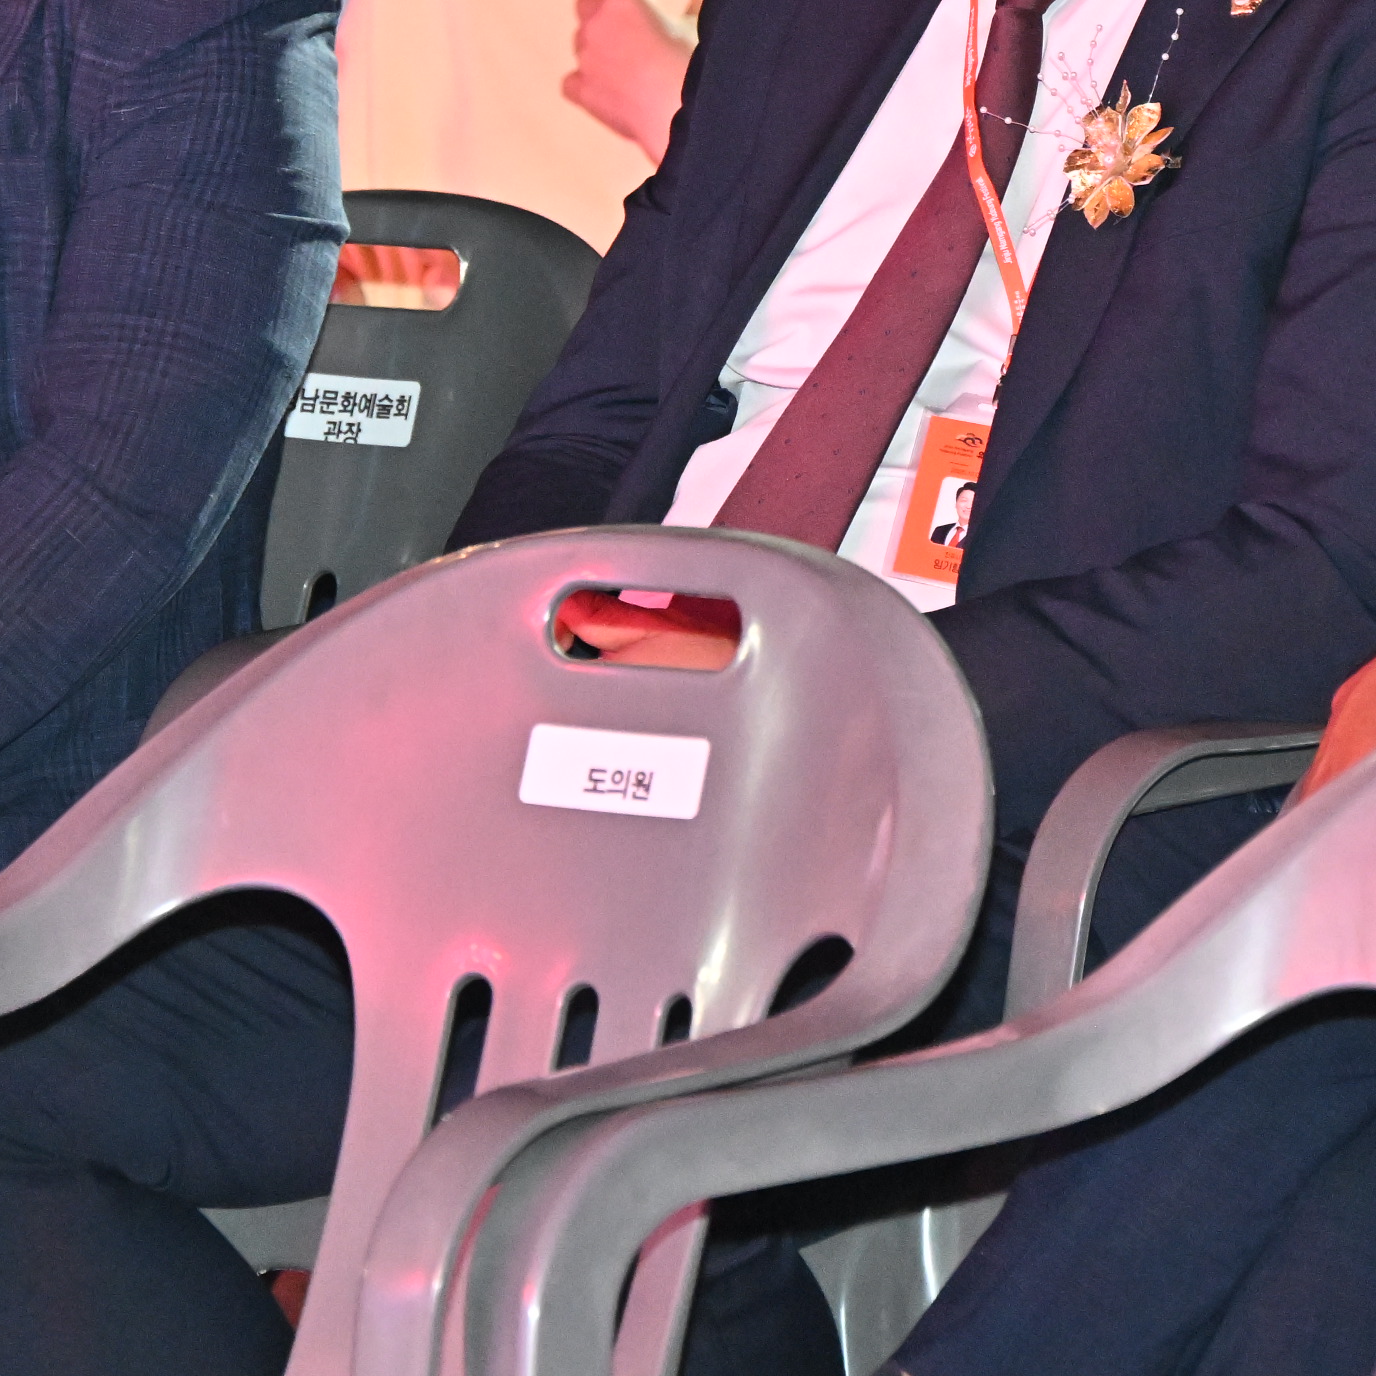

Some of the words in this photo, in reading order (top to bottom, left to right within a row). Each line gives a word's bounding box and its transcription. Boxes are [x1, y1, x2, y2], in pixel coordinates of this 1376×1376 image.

[976, 176, 990, 200] Festival
[986, 198, 998, 222] Yudeung
[994, 221, 1007, 250] Namgang
[1002, 250, 1012, 263] Jinju
[294, 387, 412, 420] 남문화예술회
[583, 767, 654, 801] 도의원
